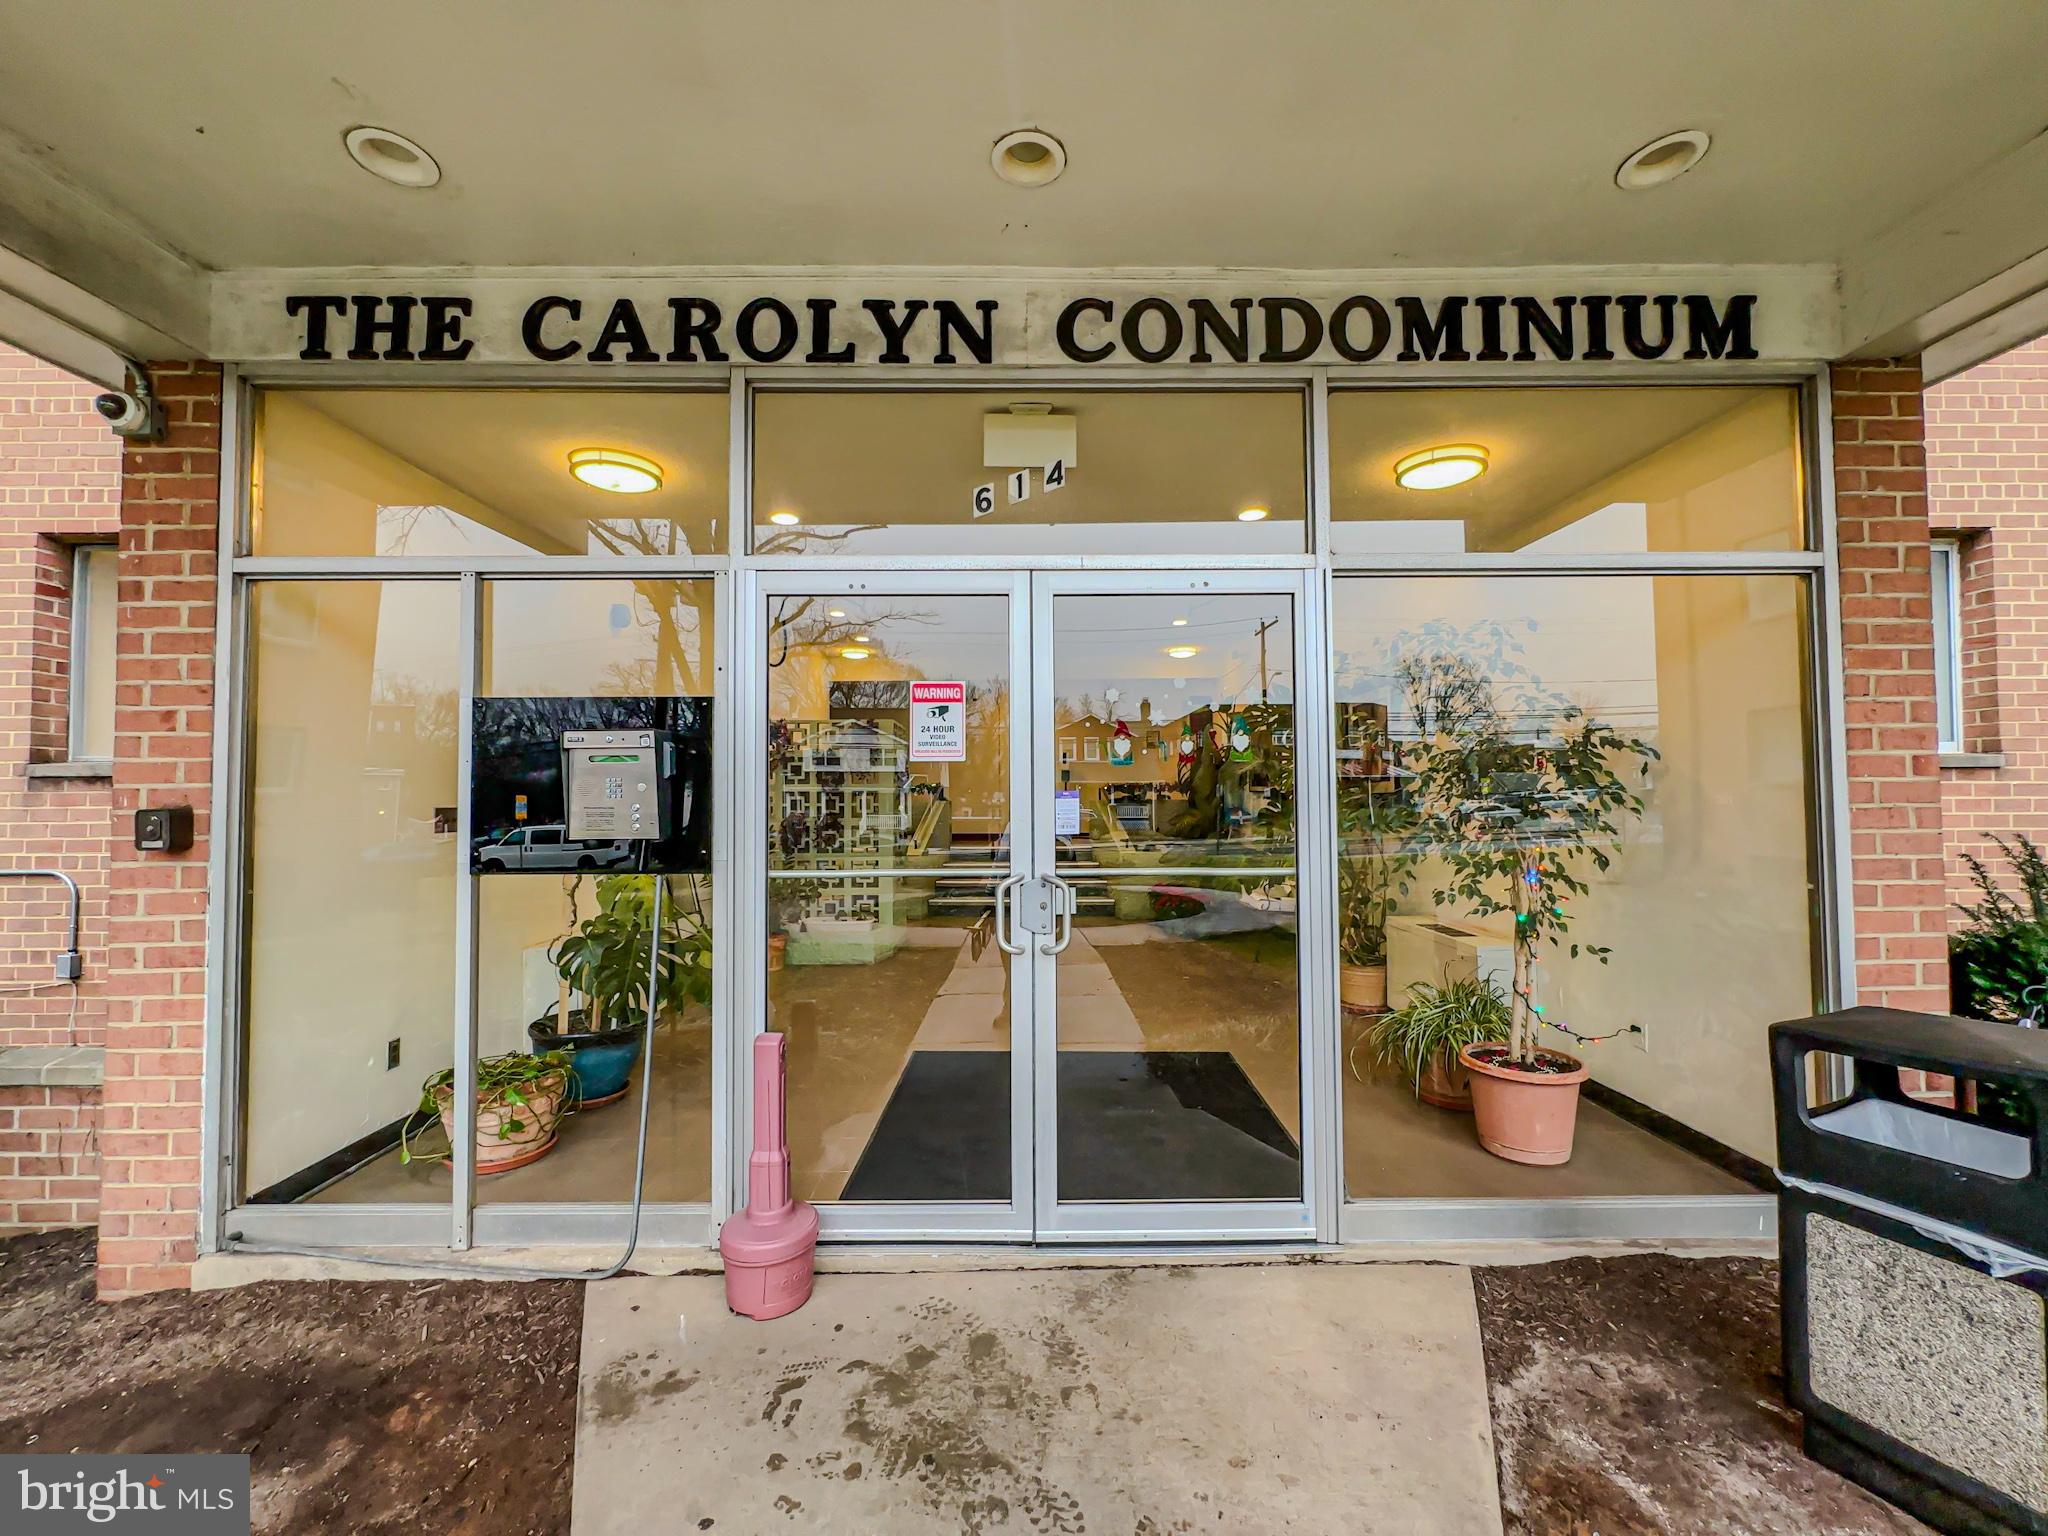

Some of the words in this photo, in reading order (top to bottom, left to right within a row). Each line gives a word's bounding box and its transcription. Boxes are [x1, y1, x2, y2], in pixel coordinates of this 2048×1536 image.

[286, 295, 474, 361] THE
[521, 295, 998, 364] CAROLYN
[1055, 294, 1760, 363] CONDOMINIUM
[914, 687, 961, 700] WARNING
[920, 725, 931, 733] 24
[933, 725, 955, 733] HOUR
